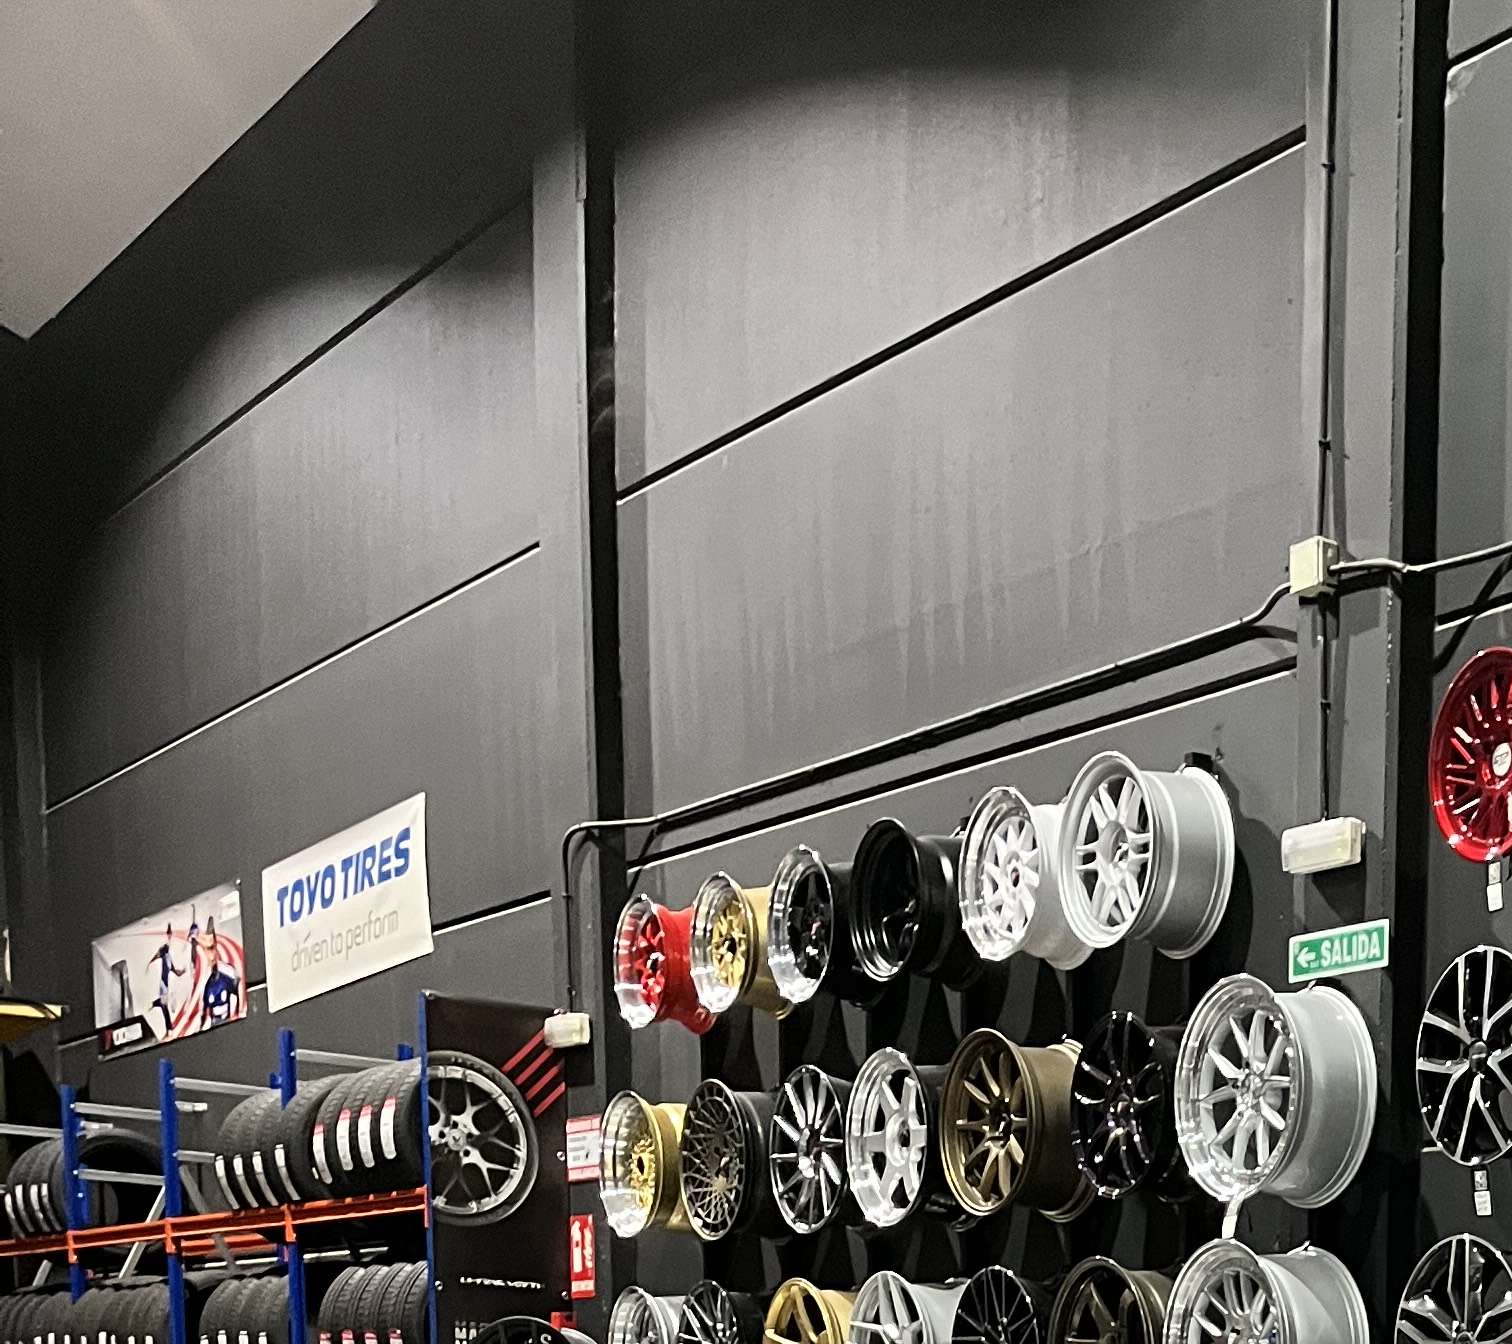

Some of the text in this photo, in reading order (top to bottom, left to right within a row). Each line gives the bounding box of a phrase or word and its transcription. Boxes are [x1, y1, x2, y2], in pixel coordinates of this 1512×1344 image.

[276, 826, 411, 928] TOYO TIRES
[291, 909, 400, 972] driven to perform
[1320, 931, 1381, 967] SALIDA
